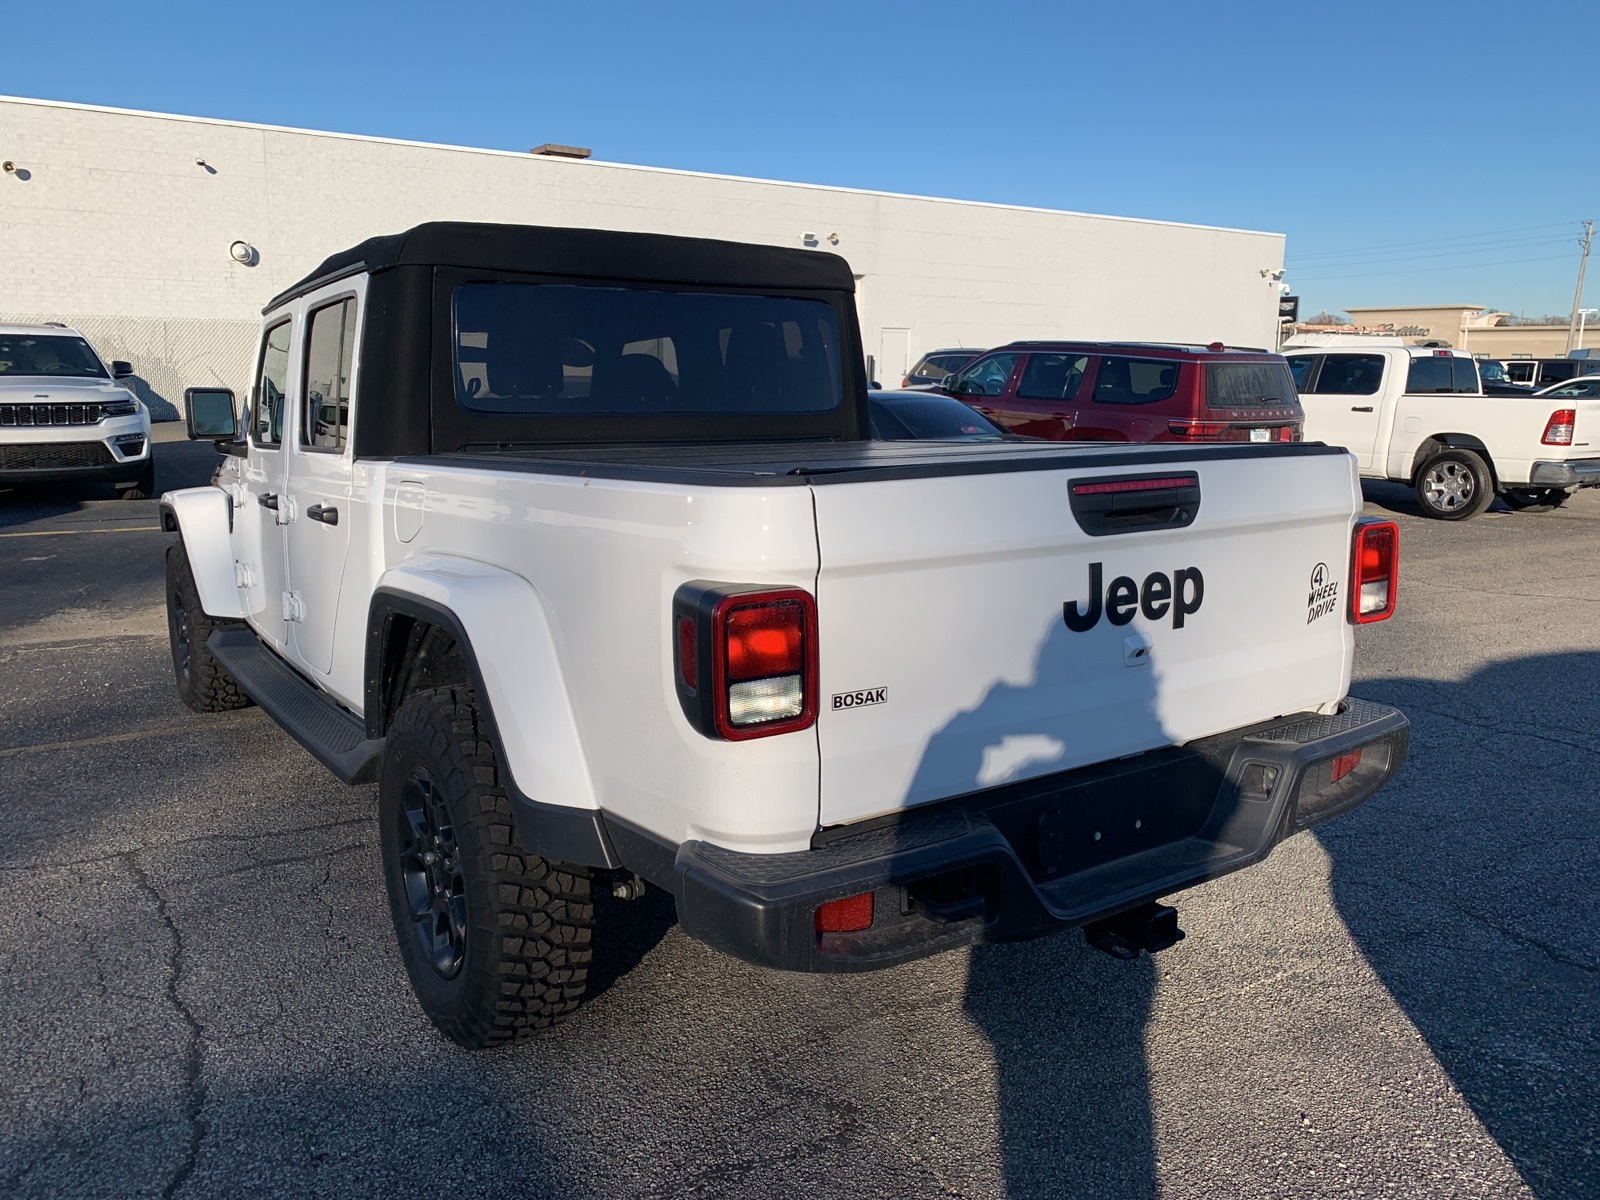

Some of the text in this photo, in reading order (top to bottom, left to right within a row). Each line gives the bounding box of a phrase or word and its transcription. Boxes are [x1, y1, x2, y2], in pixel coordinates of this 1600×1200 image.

[1377, 323, 1430, 337] Cdillac
[1063, 562, 1204, 633] Jeep
[1308, 581, 1338, 608] WHEEL
[1307, 598, 1336, 625] DRIVE
[833, 688, 886, 708] BOSAK
